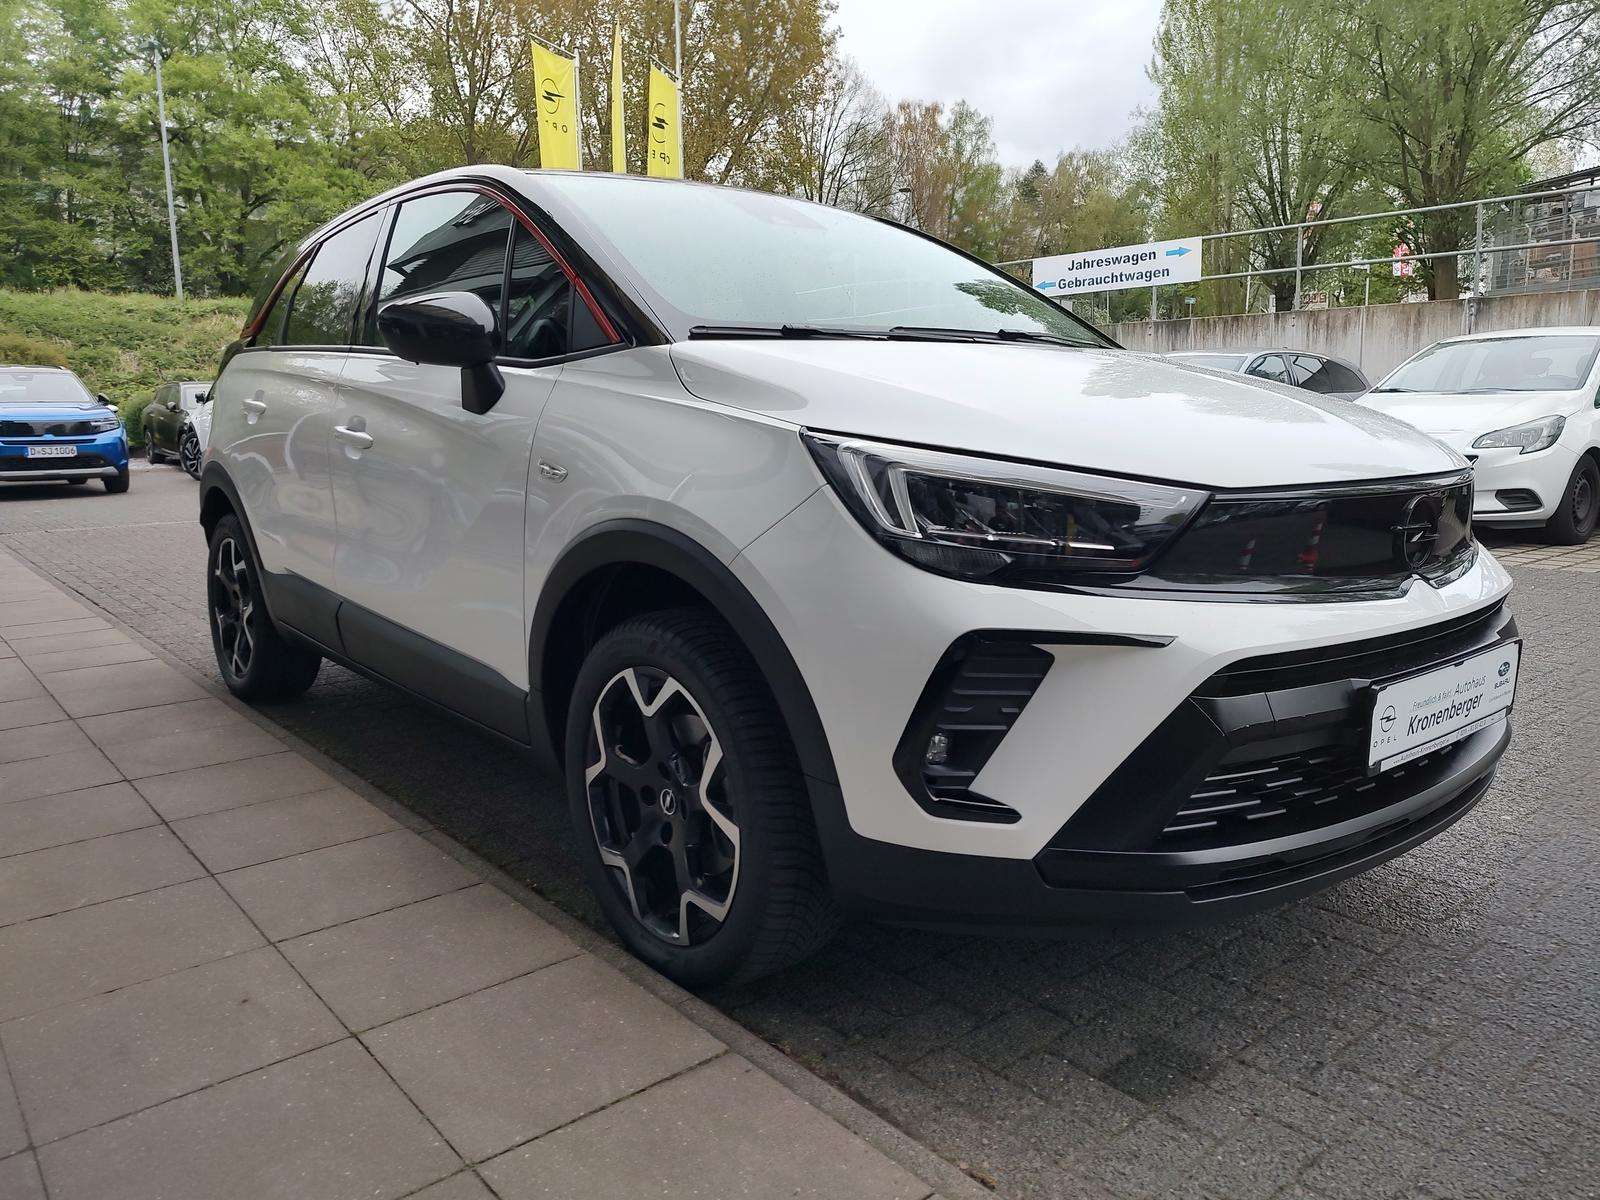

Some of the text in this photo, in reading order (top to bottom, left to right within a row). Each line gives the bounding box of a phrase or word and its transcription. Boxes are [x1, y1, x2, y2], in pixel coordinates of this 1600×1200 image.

[1067, 250, 1157, 272] Jahreswagen
[1057, 267, 1170, 290] Gebrauchtwagen
[1454, 675, 1487, 697] Autohaus
[1406, 692, 1484, 737] Kronenberger
[1373, 736, 1398, 748] OPEL
